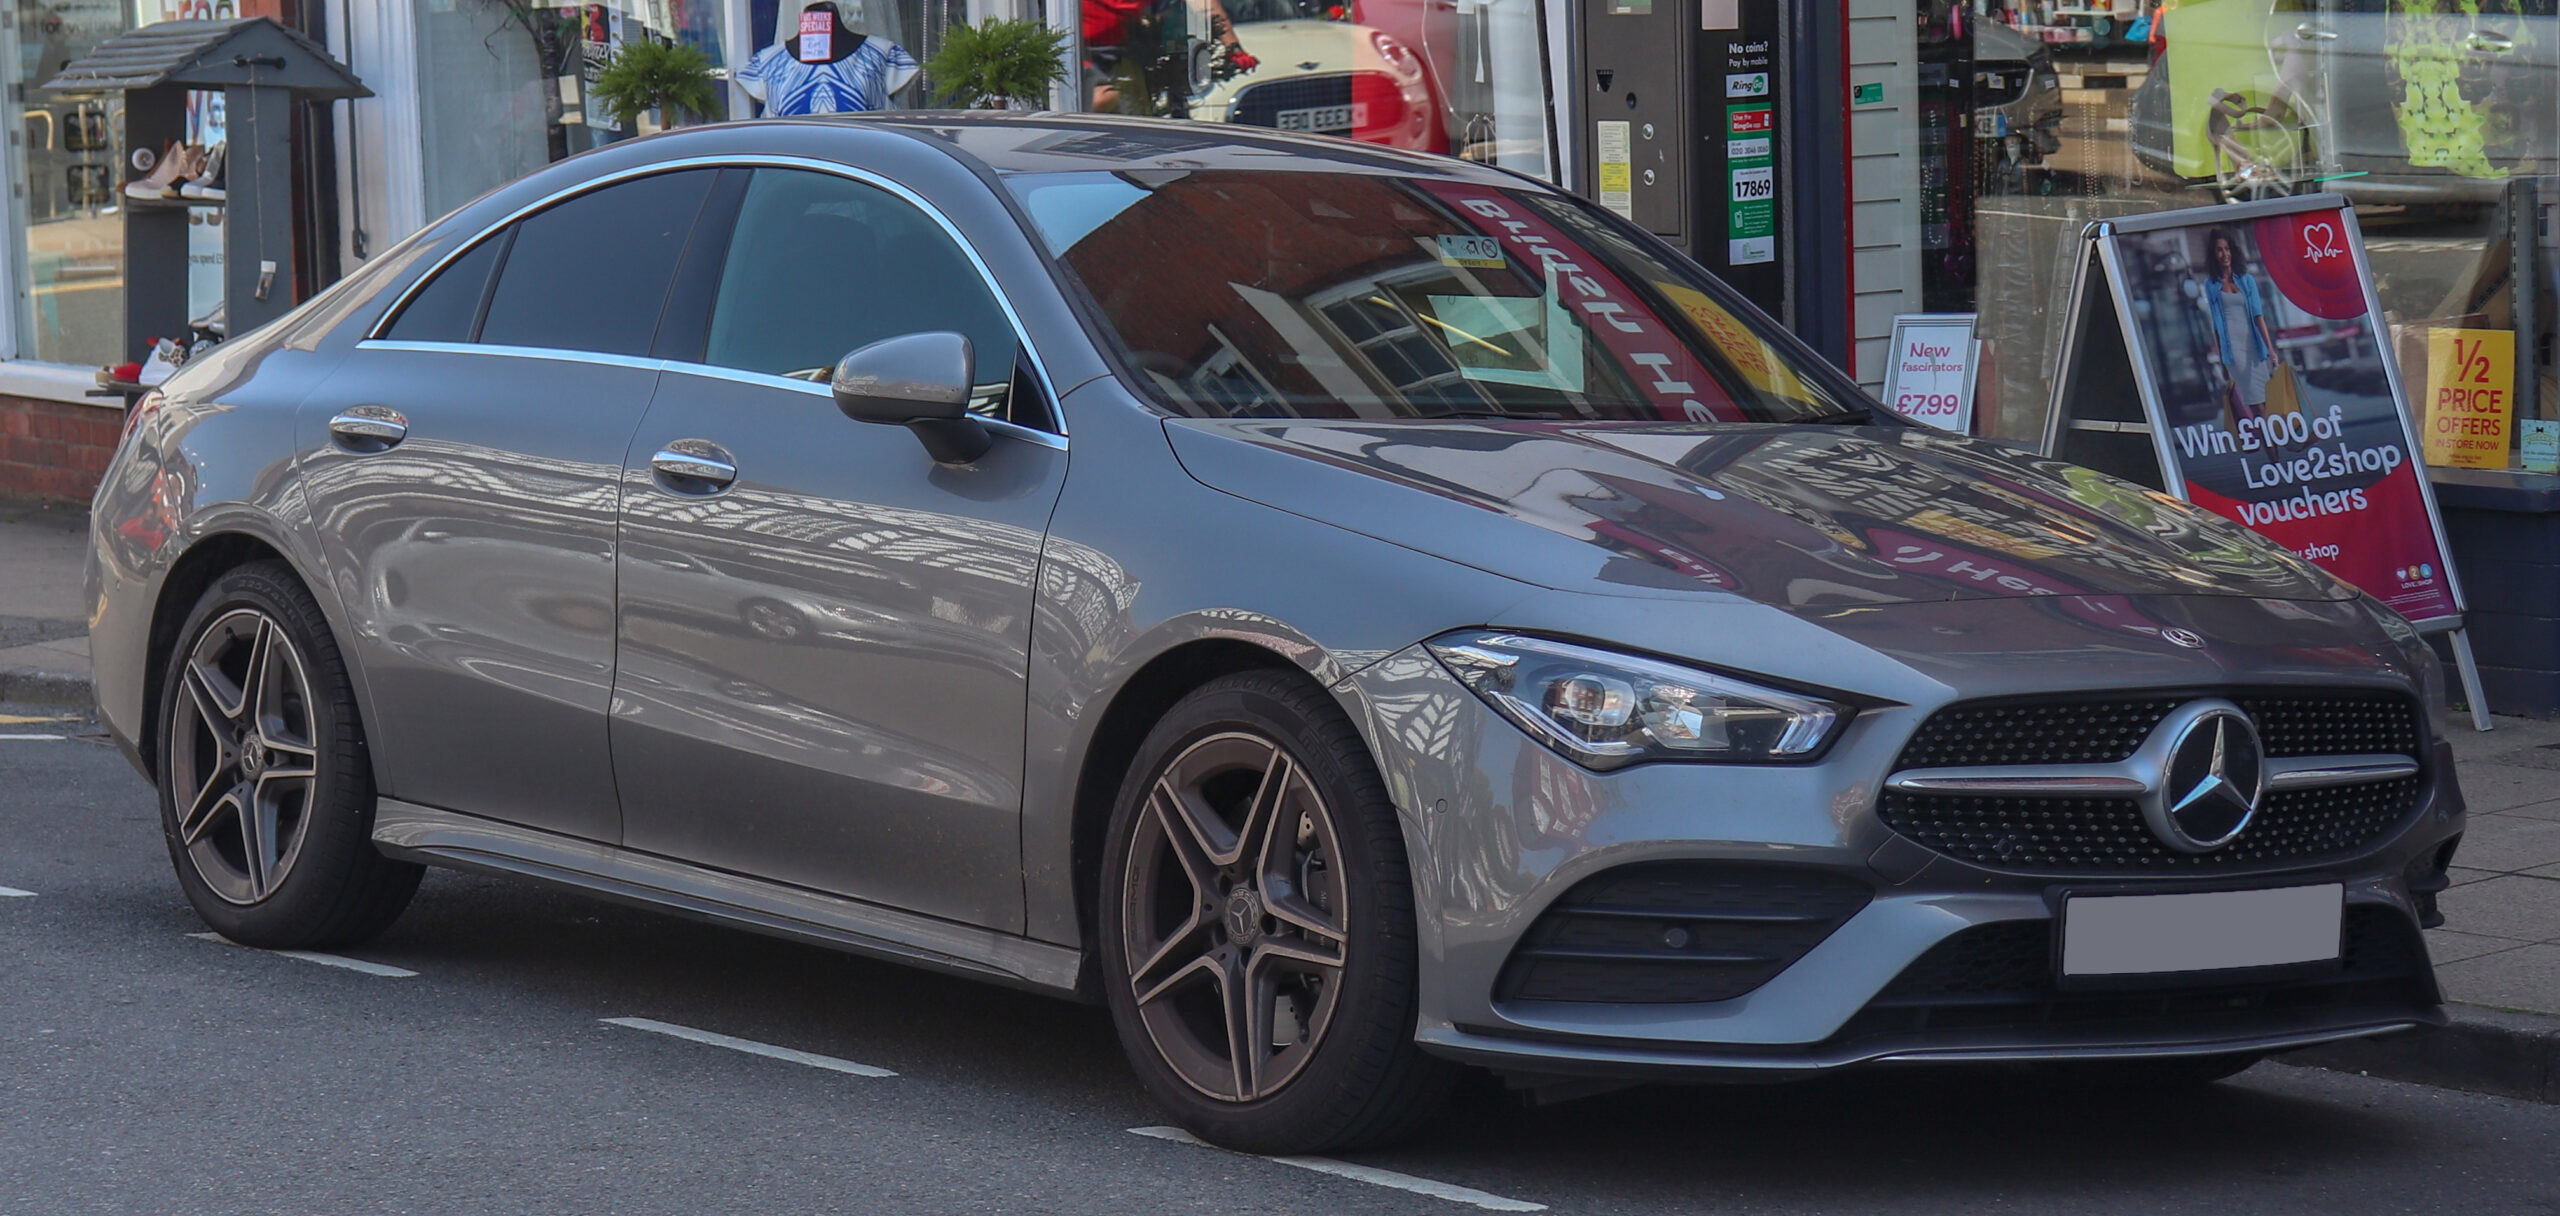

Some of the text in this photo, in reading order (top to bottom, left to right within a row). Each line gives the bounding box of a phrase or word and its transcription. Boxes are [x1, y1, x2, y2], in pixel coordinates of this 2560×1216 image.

[800, 21, 832, 32] SPECIALS
[1728, 40, 1769, 54] No coins?
[1728, 56, 1768, 69] Pay by mobile
[1732, 78, 1763, 92] RingGo
[1735, 179, 1771, 198] 17869
[1909, 342, 1951, 358] New
[1901, 362, 1964, 372] fascinators
[1896, 394, 1959, 415] £7.99
[2437, 387, 2503, 414] PRICE
[2174, 404, 2343, 459] Win £100 of
[2437, 416, 2501, 436] OFFERS
[2435, 438, 2500, 451] IN STORE NOW
[2240, 442, 2401, 489] Love2shop
[2236, 485, 2368, 527] vouchers
[2304, 543, 2340, 561] shop
